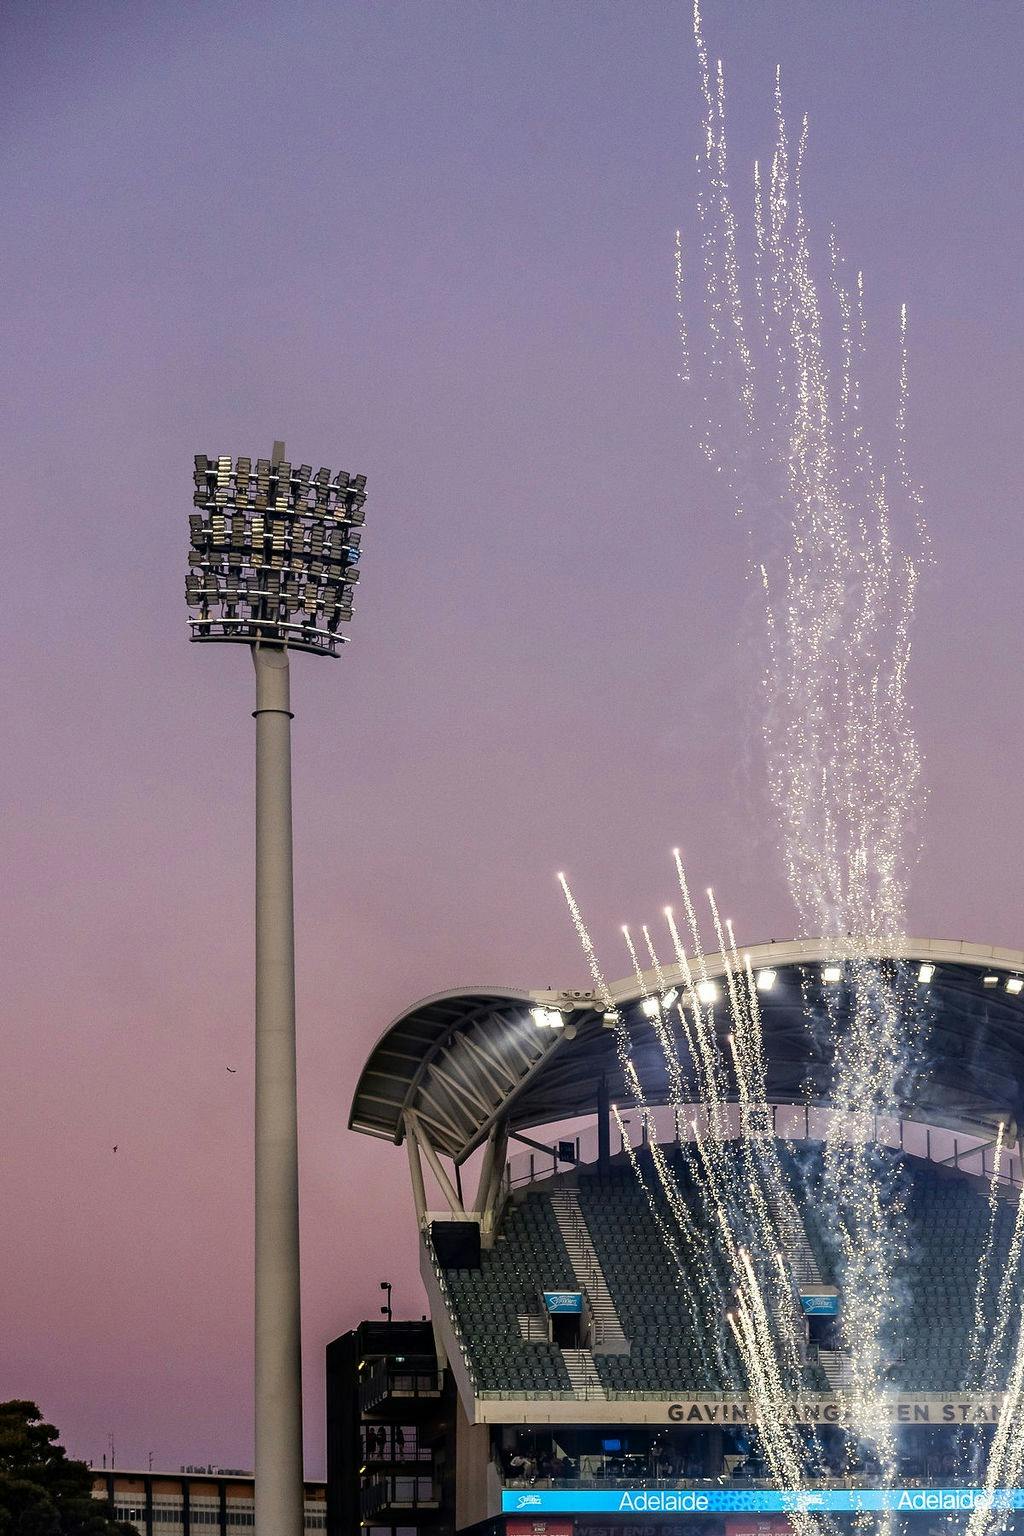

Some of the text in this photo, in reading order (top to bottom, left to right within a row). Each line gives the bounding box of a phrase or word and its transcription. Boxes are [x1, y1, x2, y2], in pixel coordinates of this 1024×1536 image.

[668, 1404, 748, 1422] GAVIN
[619, 1491, 708, 1511] Adelaide
[898, 1490, 989, 1509] Adelaide
